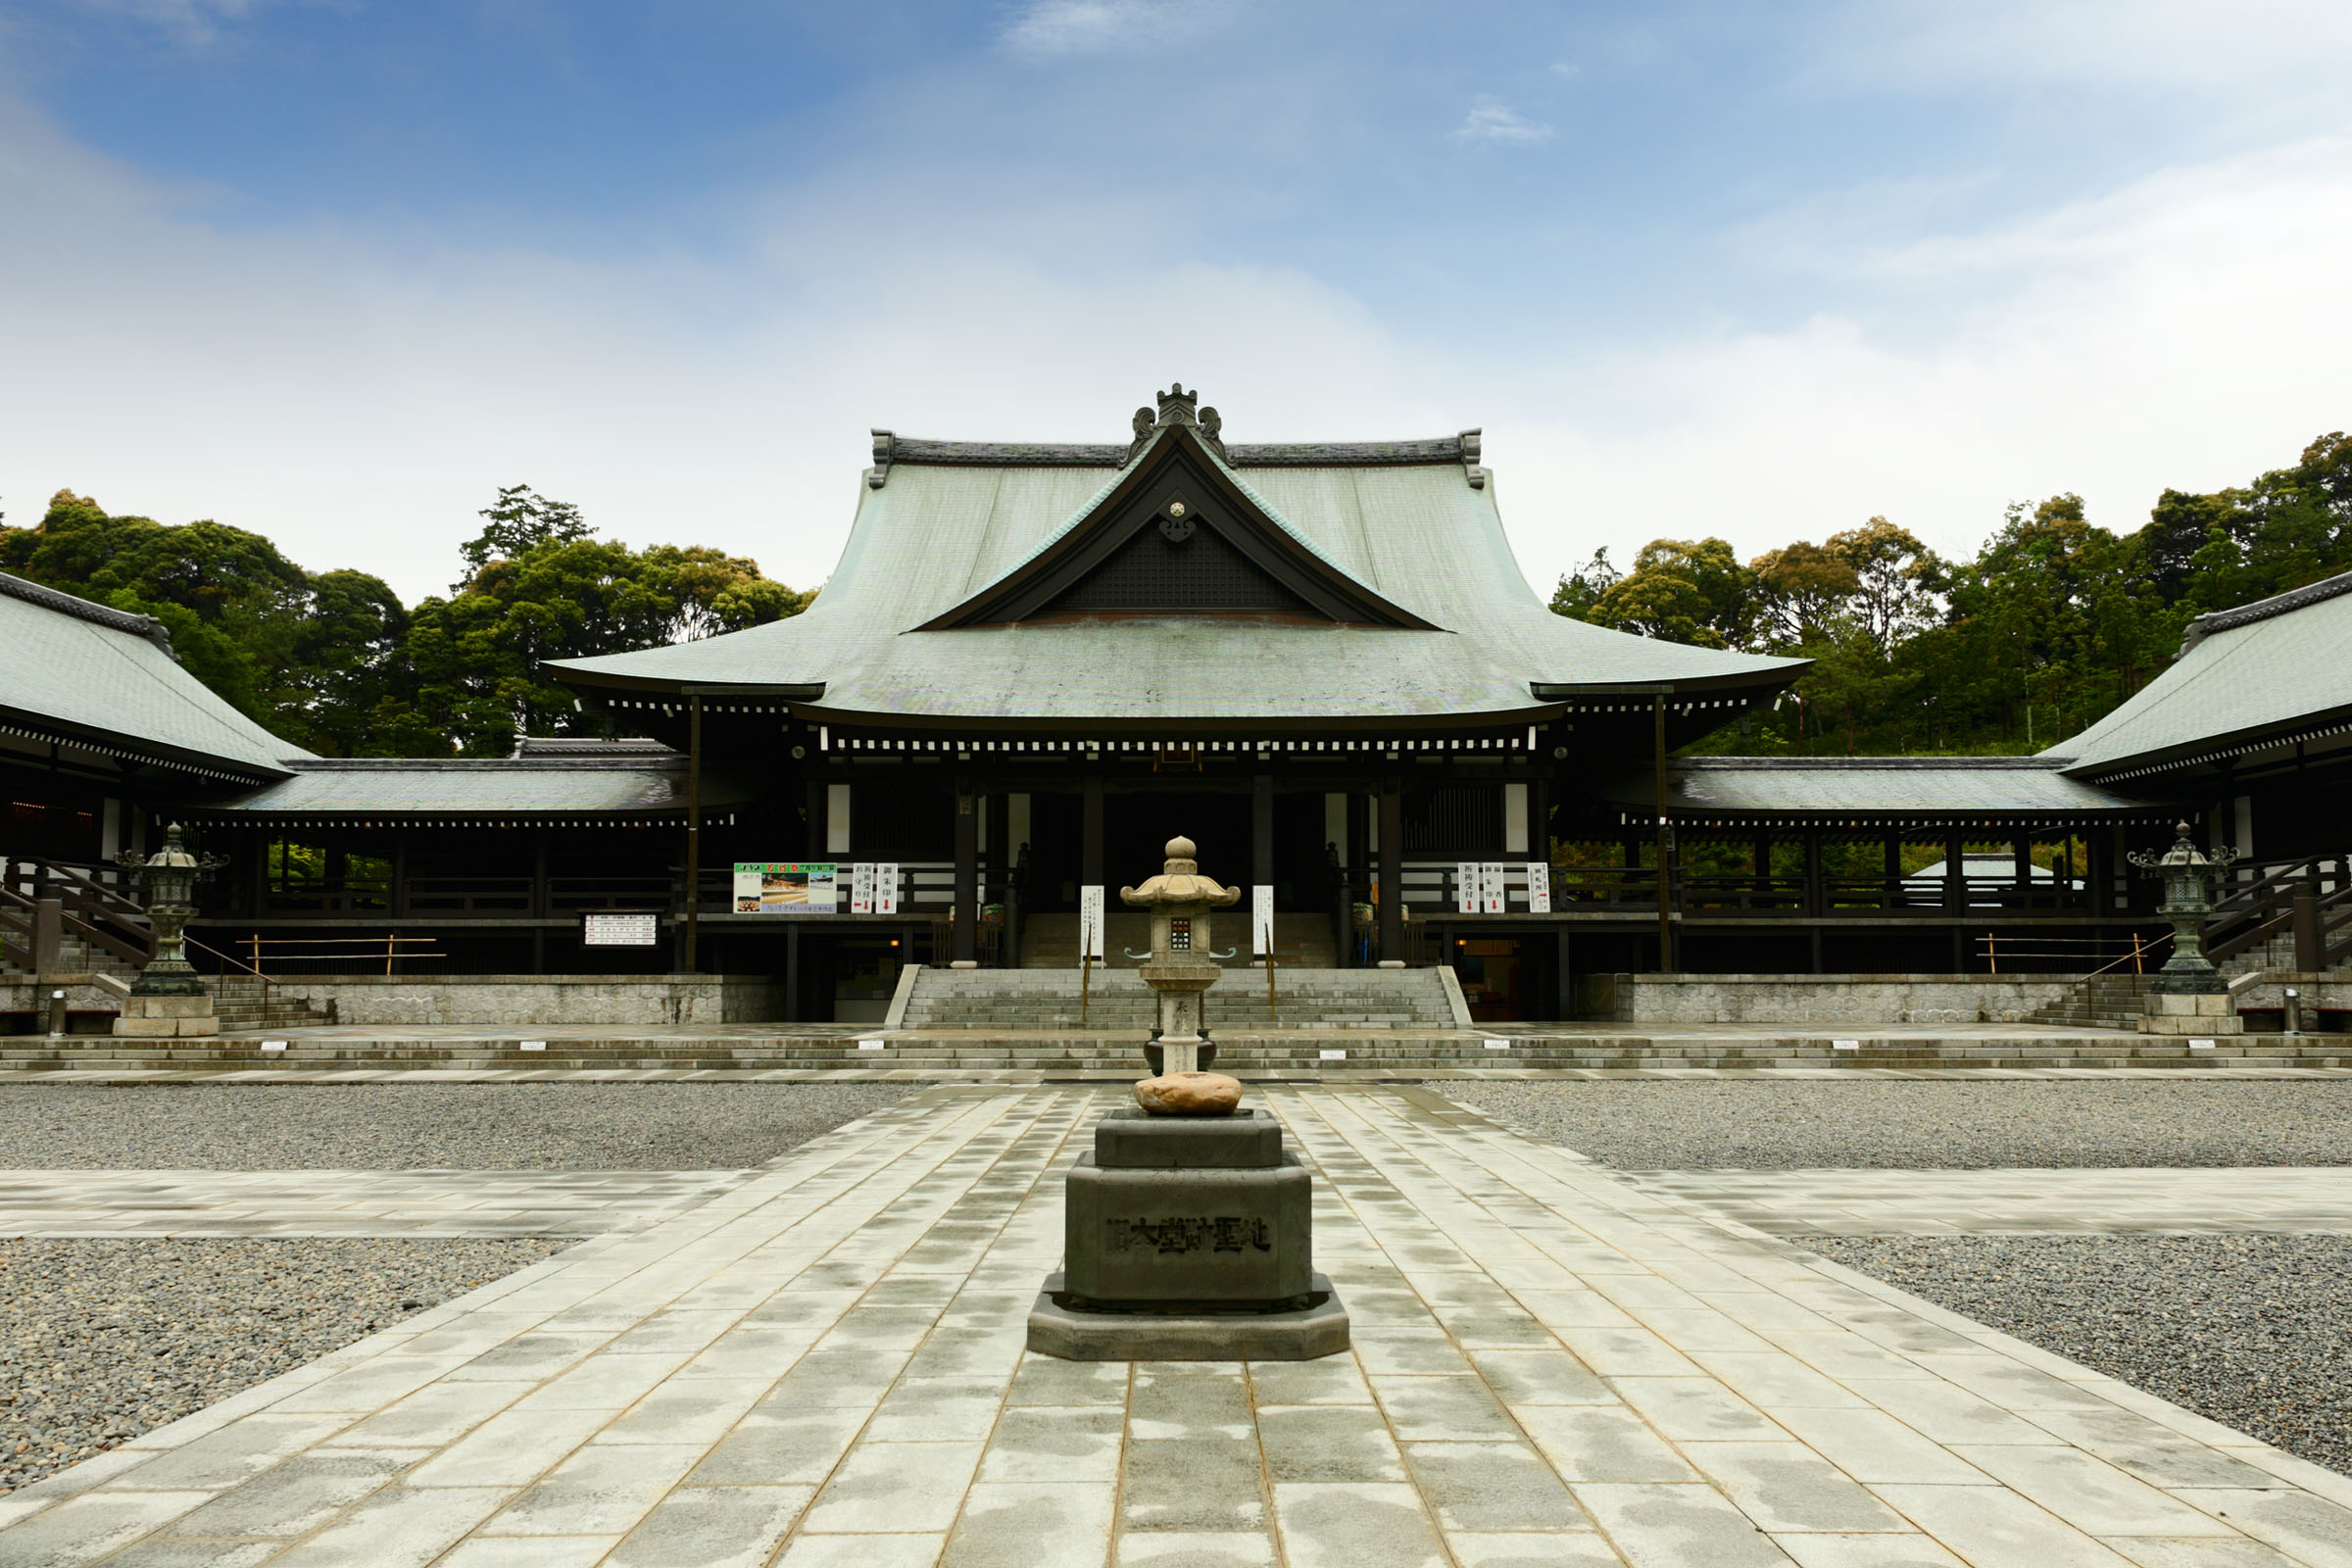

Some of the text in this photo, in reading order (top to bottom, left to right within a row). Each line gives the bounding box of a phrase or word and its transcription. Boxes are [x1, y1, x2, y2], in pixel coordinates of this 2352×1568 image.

[855, 865, 863, 898] お守り
[882, 866, 893, 897] 御朱印
